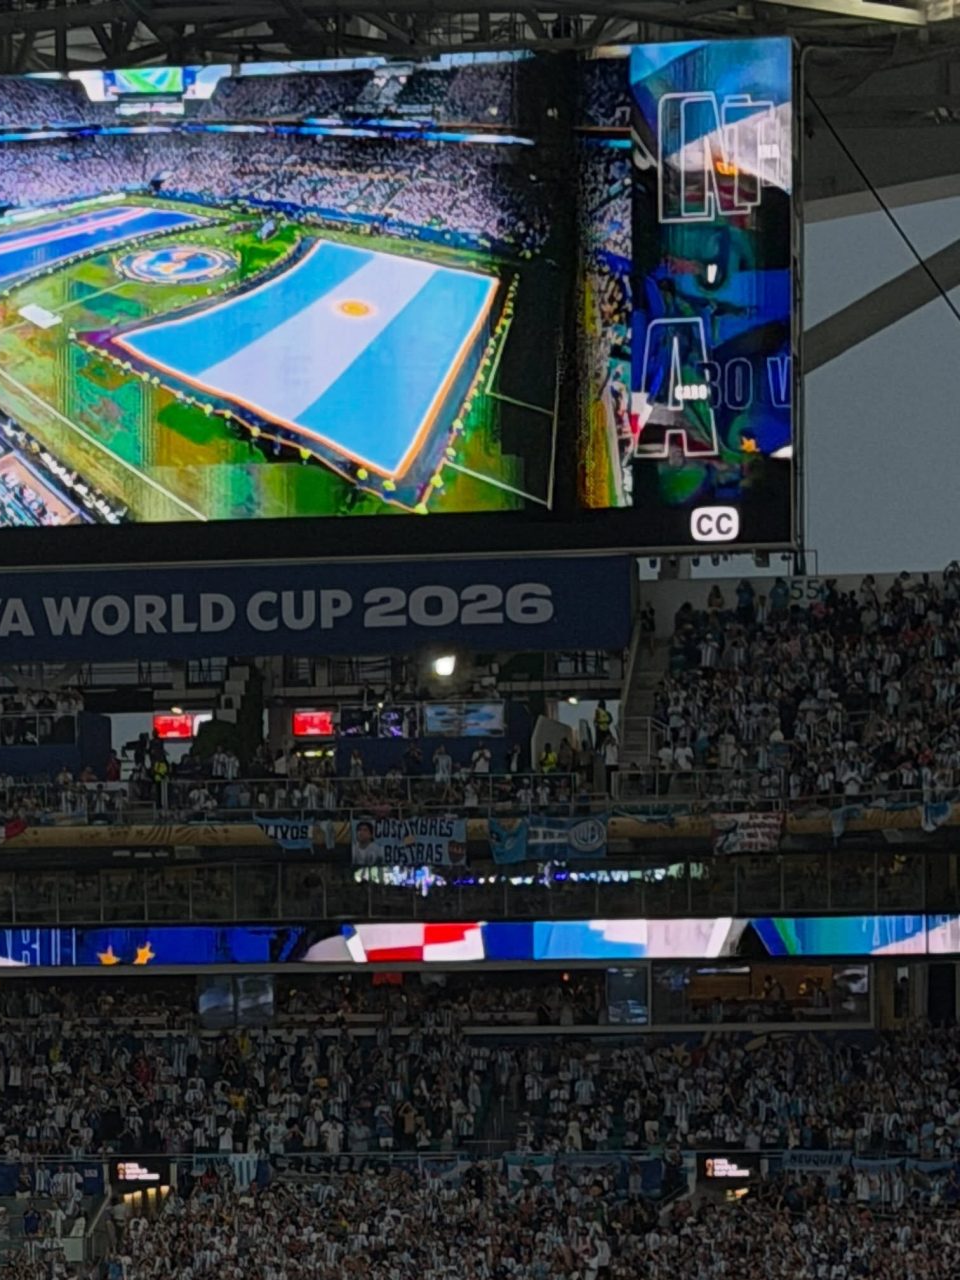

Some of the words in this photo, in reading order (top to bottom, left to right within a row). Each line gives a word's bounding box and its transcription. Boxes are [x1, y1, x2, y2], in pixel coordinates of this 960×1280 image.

[696, 513, 731, 535] CC
[42, 592, 236, 637] WORLD
[246, 588, 352, 632] CUP
[363, 582, 554, 627] 2026
